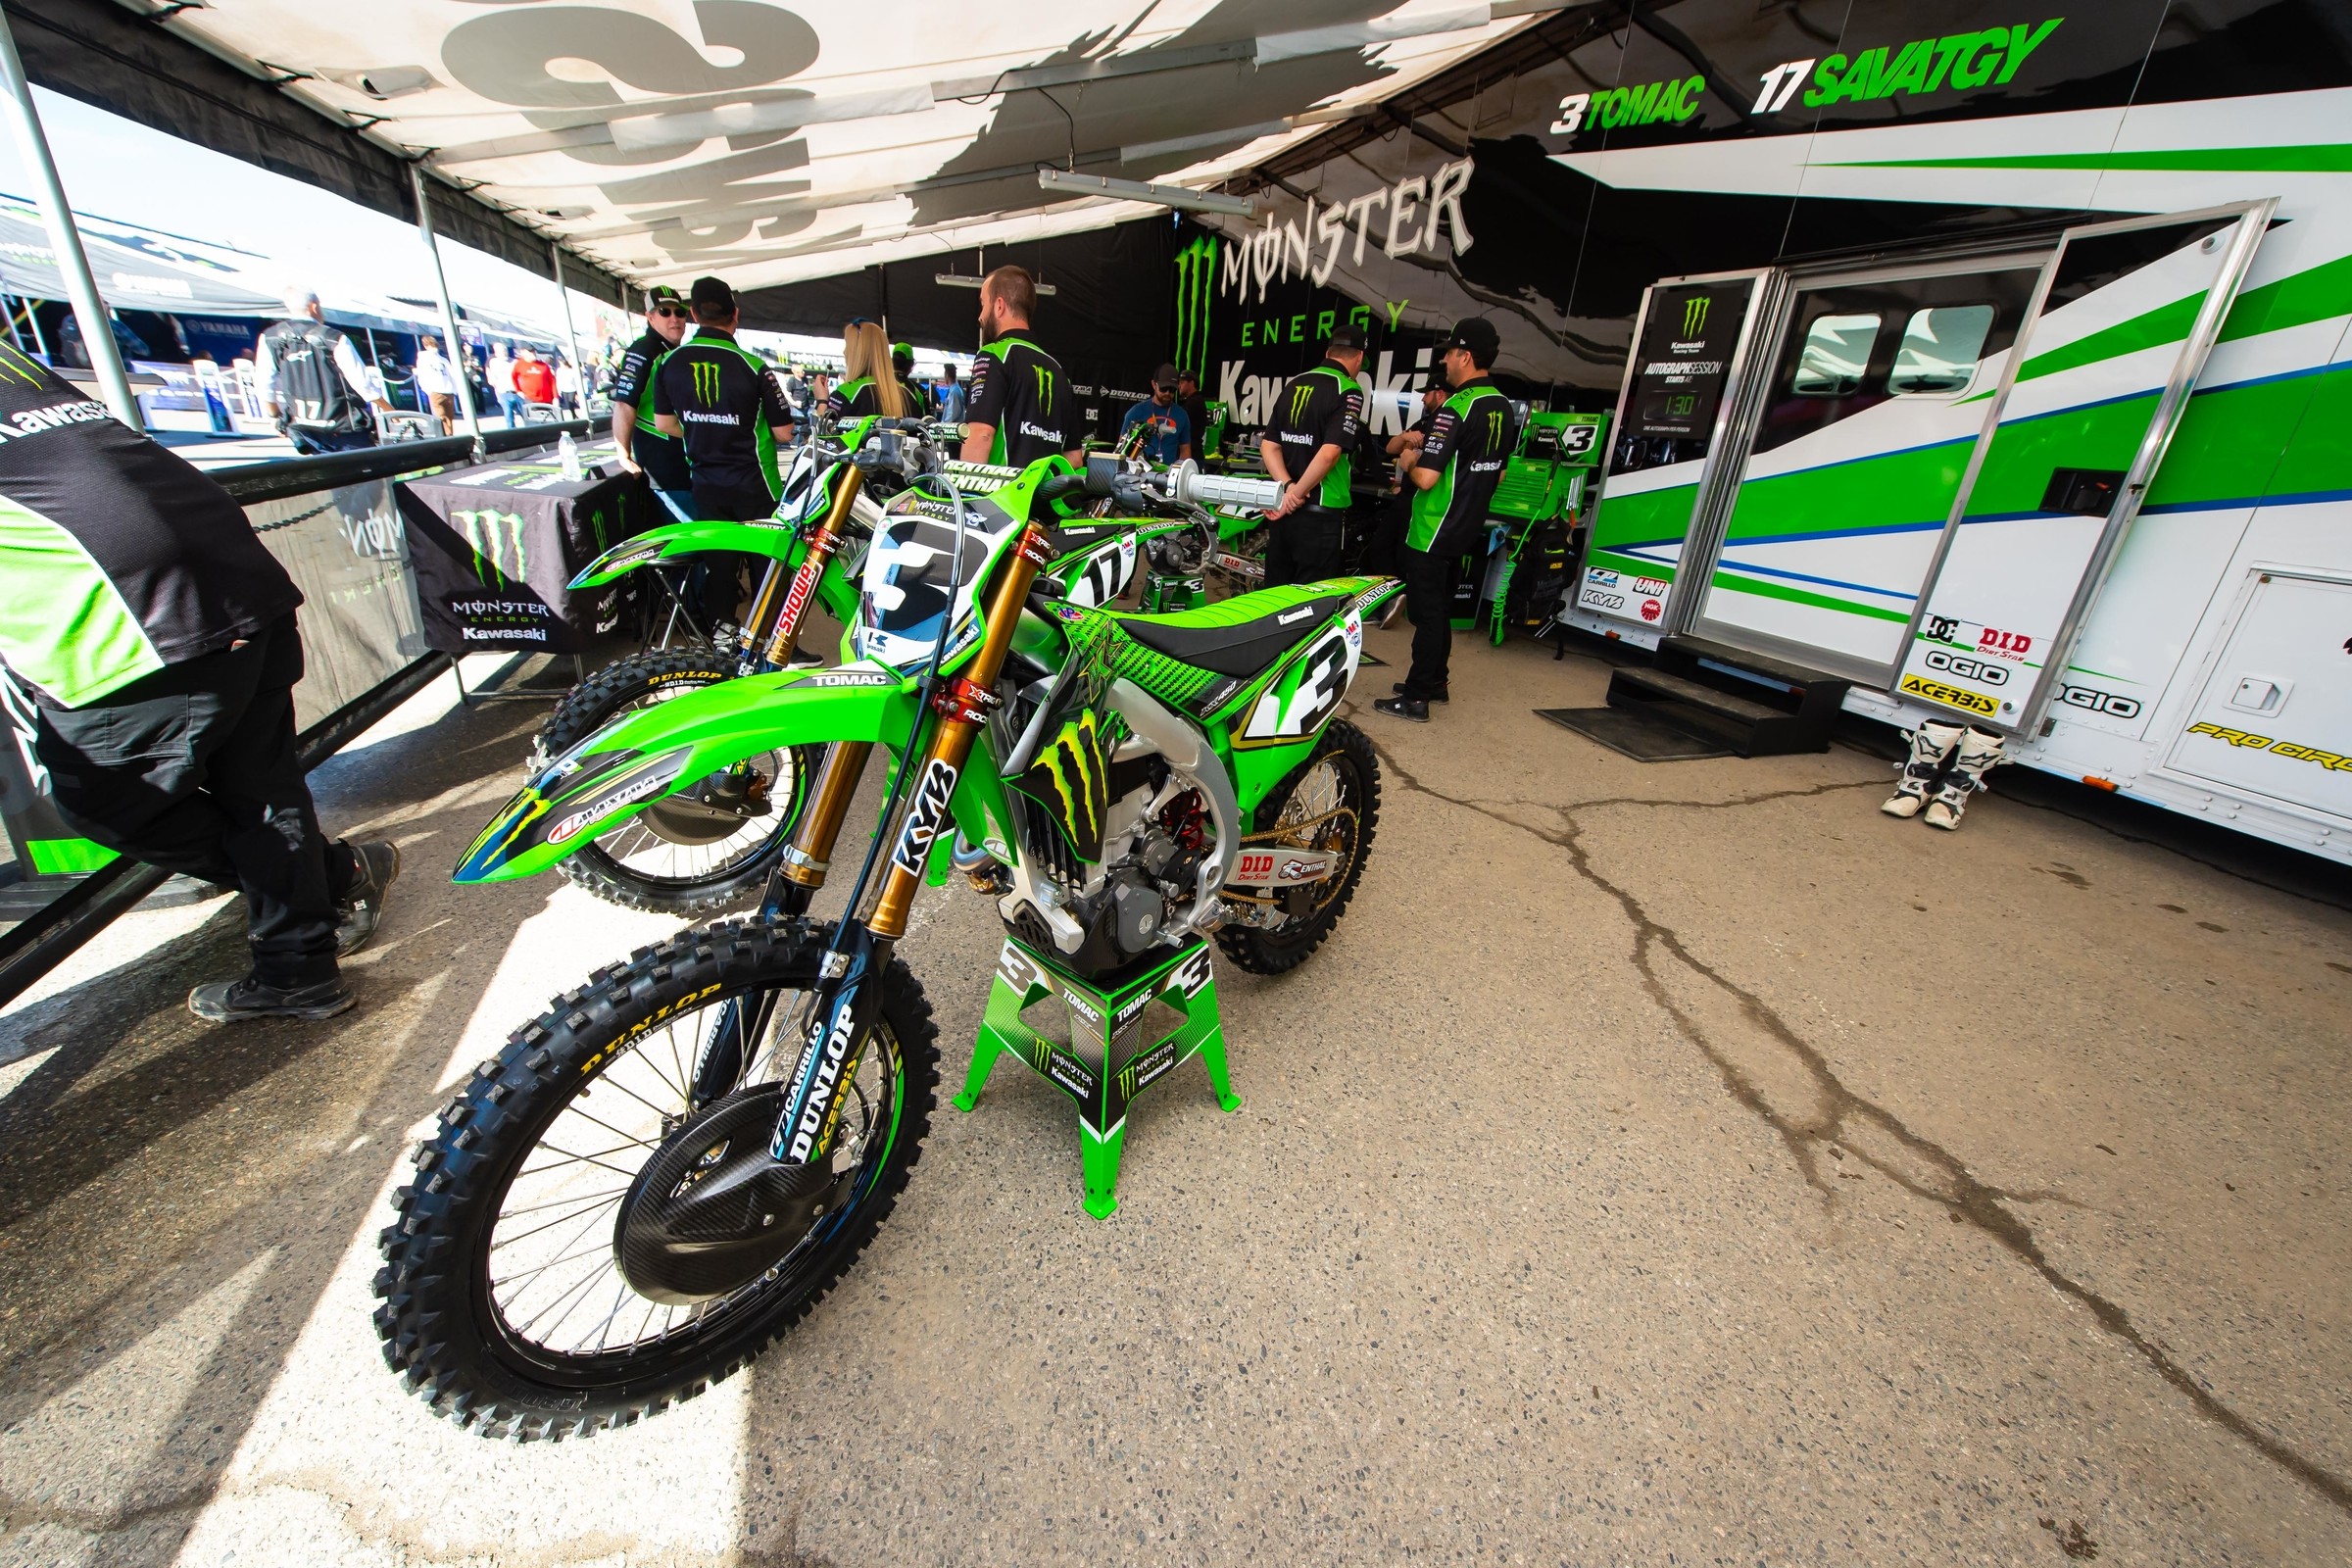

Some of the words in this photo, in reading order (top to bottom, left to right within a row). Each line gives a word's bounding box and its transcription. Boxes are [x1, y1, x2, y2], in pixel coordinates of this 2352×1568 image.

[201, 321, 250, 336] YAMAHA
[1242, 299, 1409, 347] ENERGY
[1109, 389, 1151, 399] DUNLOP
[1218, 348, 1433, 437] Kawki
[1665, 396, 1694, 415] 1:30
[0, 400, 115, 444] awas
[294, 399, 321, 419] 17
[683, 410, 740, 426] Kawasaki
[1020, 420, 1063, 444] Kawsak
[1281, 431, 1314, 447] waaki
[1566, 426, 1595, 451] 3
[1470, 460, 1502, 471] Kaasi
[914, 500, 956, 516] MONSTE
[1138, 521, 1175, 534] DUNLOP
[1081, 546, 1121, 608] 17
[1191, 579, 1203, 592] 3
[1588, 578, 1617, 589] CARRILLO
[1635, 577, 1667, 597] UNI
[452, 599, 550, 617] MONSTER
[778, 563, 815, 636] SHOWA
[1356, 583, 1391, 611] DUNLOP
[1582, 589, 1625, 610] KYB
[463, 626, 547, 641] Kawasaki
[648, 671, 722, 686] DUNLOP
[811, 674, 887, 687] TOMAC
[1926, 651, 2009, 686] OGIO
[1298, 635, 1348, 736] 3
[2186, 721, 2275, 749] PRO
[893, 760, 956, 877] KYB
[1000, 947, 1037, 993] 3
[1181, 947, 1211, 999] 3
[1062, 988, 1101, 1023] TOMAC
[1116, 988, 1152, 1023] TOMAC
[581, 983, 722, 1077] DUNLOP
[785, 1021, 823, 1112] CARRILLO
[1139, 1056, 1174, 1087] Kawasaki
[789, 1004, 855, 1164] DUNLOP
[1051, 1066, 1090, 1100] Kawasaki
